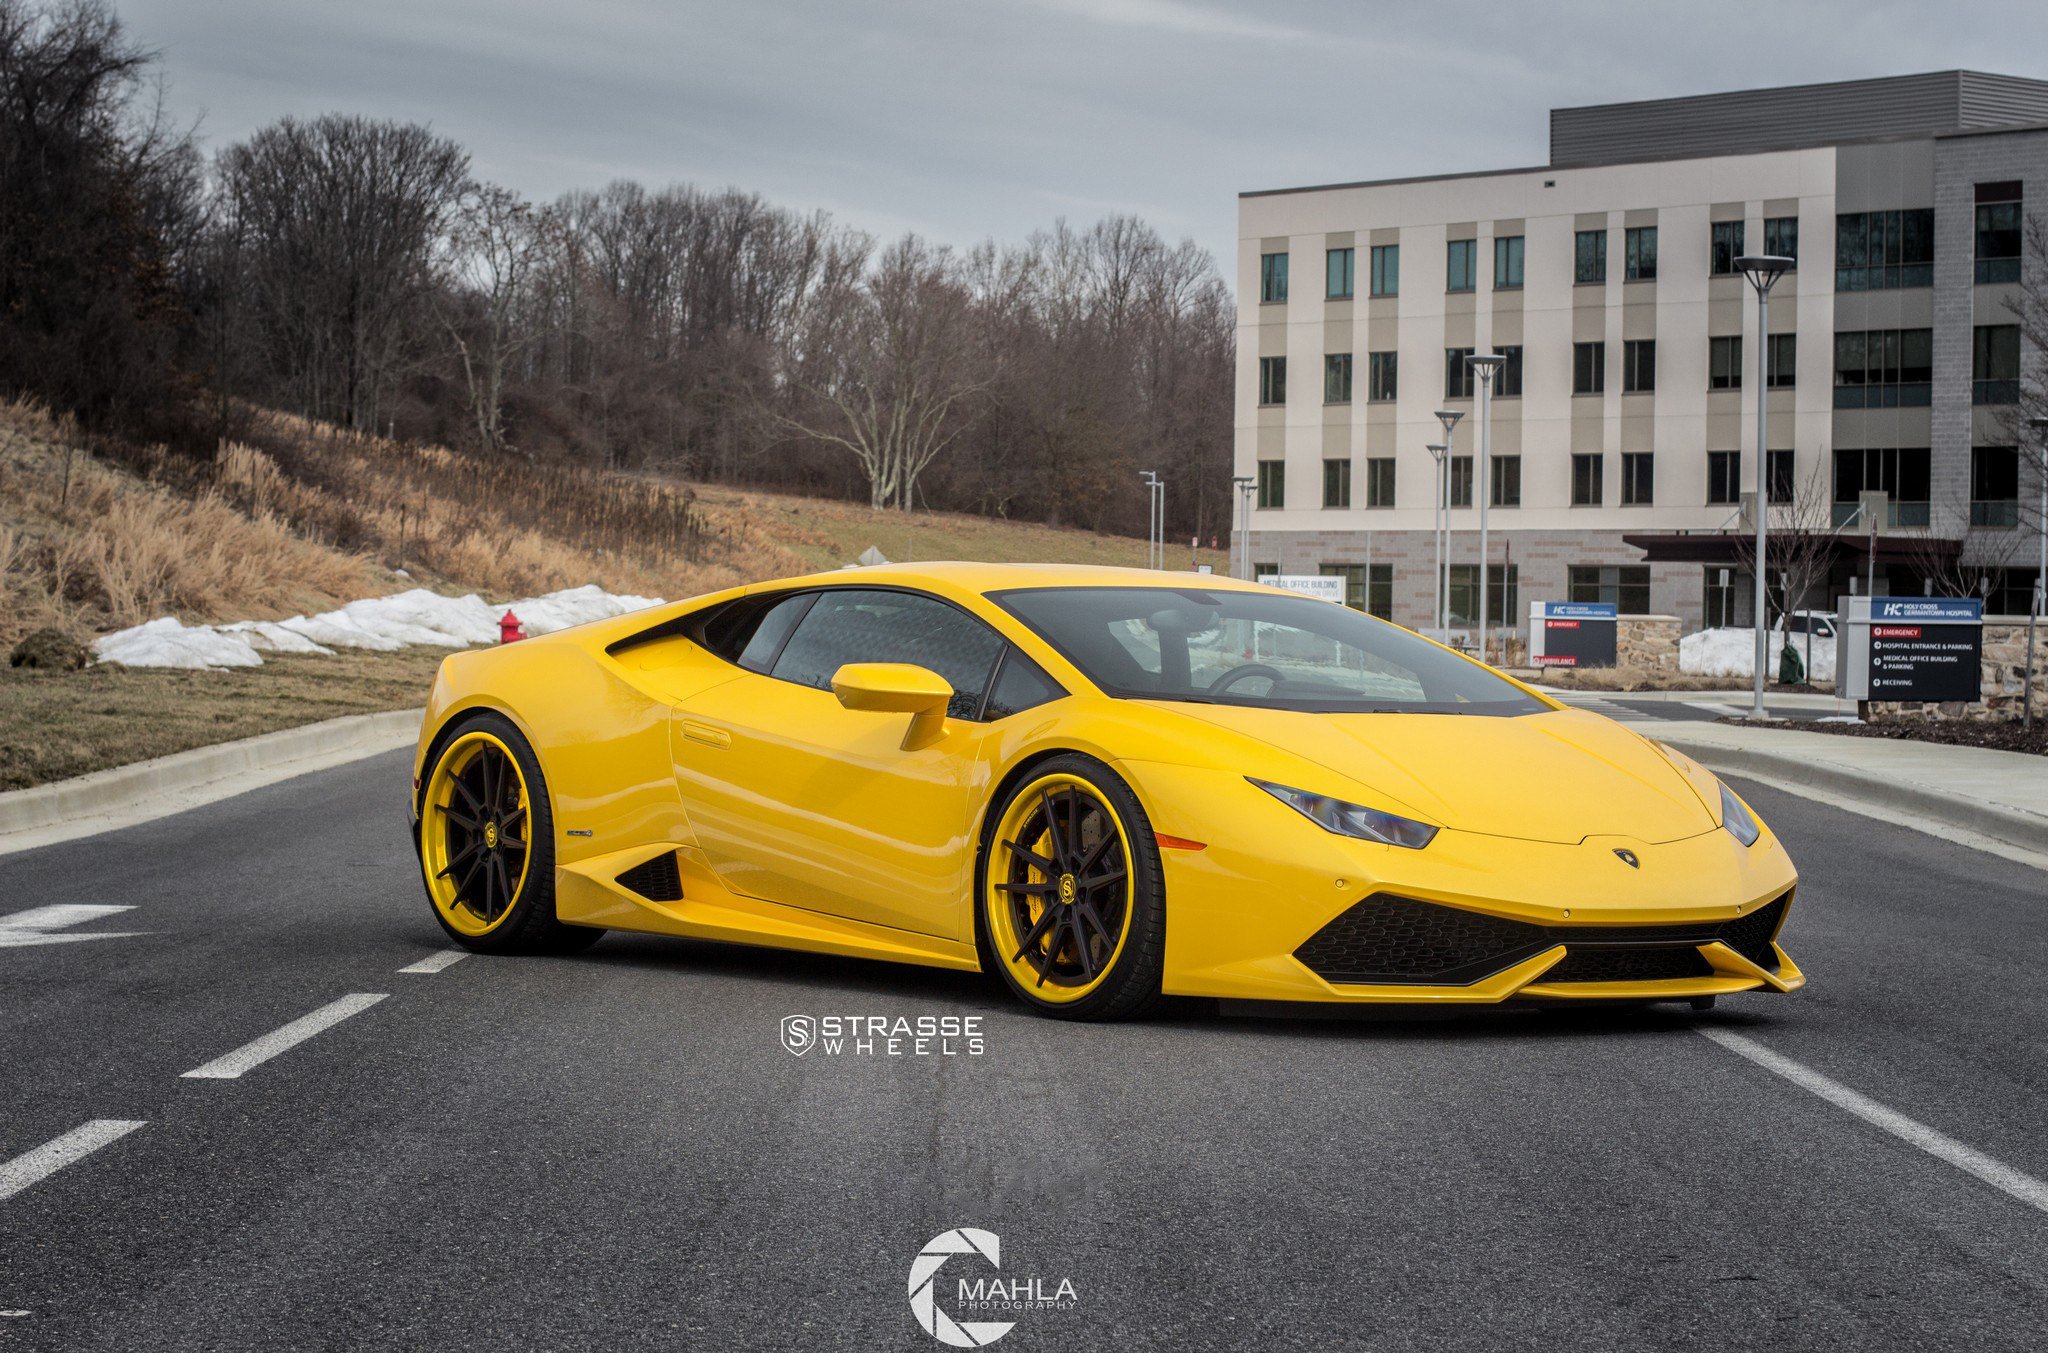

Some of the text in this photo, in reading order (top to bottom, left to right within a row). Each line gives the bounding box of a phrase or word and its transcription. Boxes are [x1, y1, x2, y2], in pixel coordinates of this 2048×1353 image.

[1290, 580, 1309, 589] OFFICE
[1311, 580, 1338, 589] BUILDING
[1884, 603, 1903, 615] HC
[1539, 657, 1576, 665] AMBULANCE
